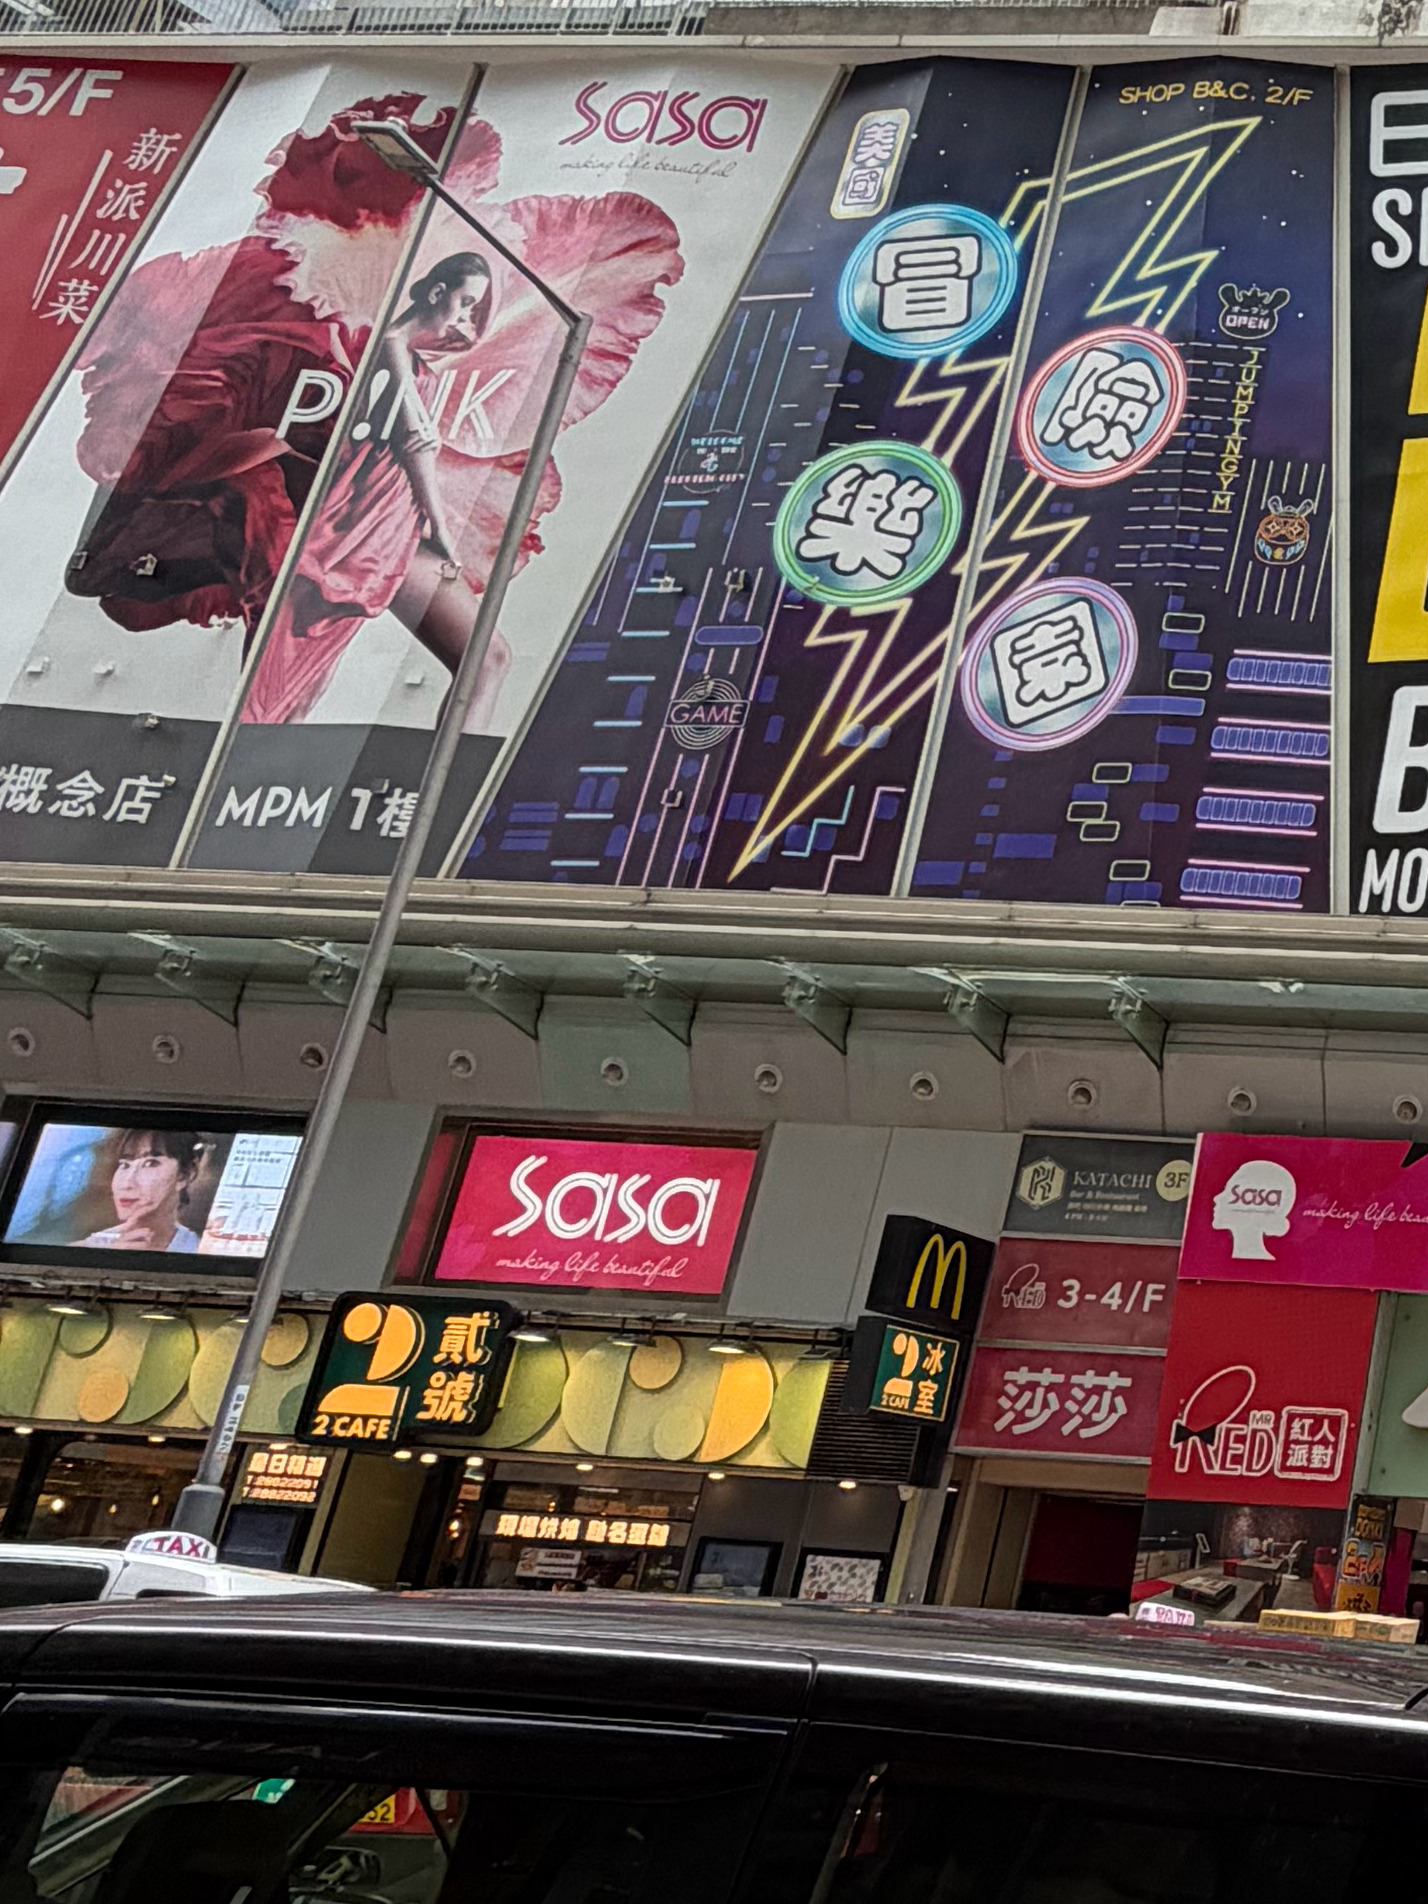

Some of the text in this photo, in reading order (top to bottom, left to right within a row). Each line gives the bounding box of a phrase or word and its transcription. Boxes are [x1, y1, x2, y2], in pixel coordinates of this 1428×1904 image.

[1118, 82, 1185, 104] SHOP
[1264, 86, 1314, 106] 2/F
[560, 155, 613, 178] making
[842, 121, 900, 206] 美國
[38, 127, 183, 326] 新派川菜
[1225, 315, 1270, 331] OPEN
[668, 700, 747, 727] GAME
[0, 763, 166, 824] 概念店
[215, 785, 333, 828] MPM
[1072, 1170, 1153, 1189] KATACHI
[1302, 1200, 1361, 1230] making
[1362, 1201, 1397, 1231] life
[495, 1249, 690, 1289] making life beautiful
[1056, 1278, 1166, 1314] 3-4/F
[914, 1341, 946, 1415] 冰室
[993, 1365, 1133, 1440] 莎莎
[333, 1417, 393, 1442] CAFE
[1289, 1417, 1336, 1443] 紅人
[1285, 1443, 1335, 1469] 派對
[153, 1536, 211, 1559] TAXI
